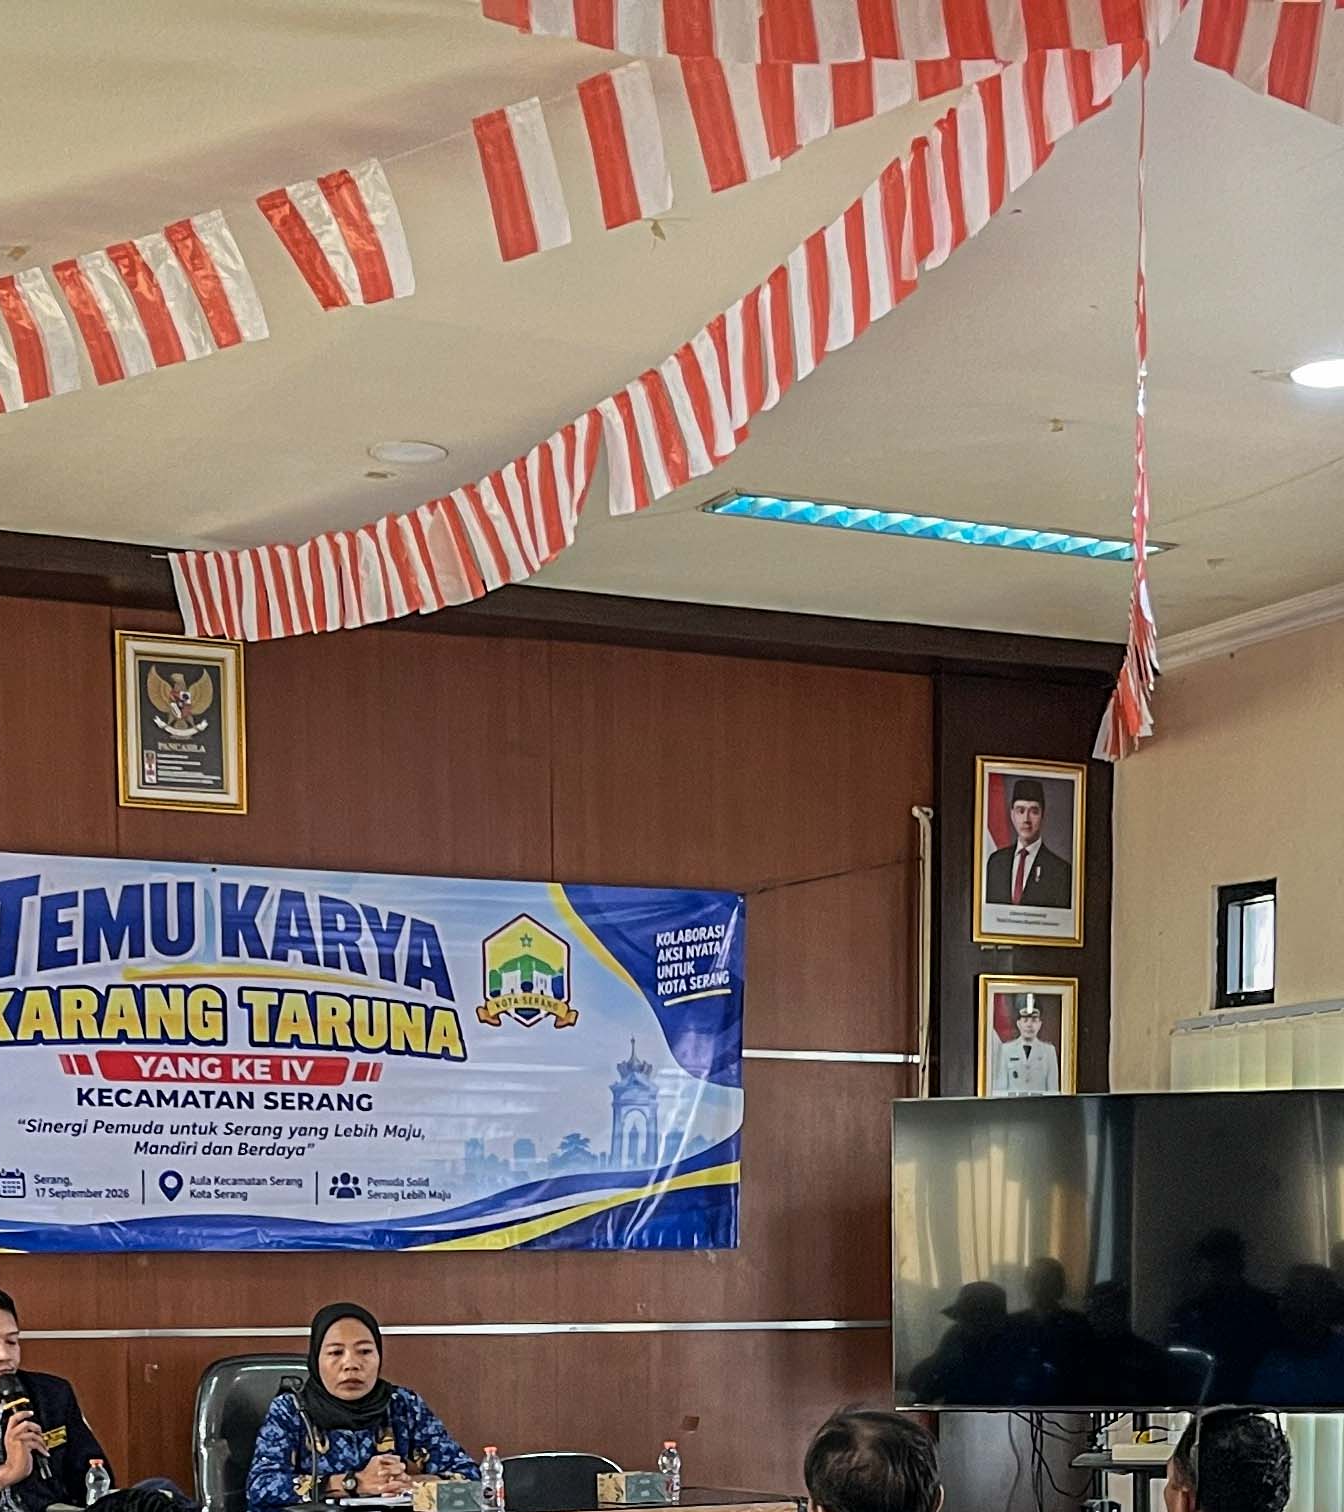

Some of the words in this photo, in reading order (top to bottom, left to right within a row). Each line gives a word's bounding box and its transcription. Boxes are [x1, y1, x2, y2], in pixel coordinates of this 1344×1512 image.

[220, 882, 456, 1002] KARYA
[656, 924, 725, 947] KOLABORASI
[657, 947, 683, 963] AKSI
[686, 941, 721, 958] NYATA
[657, 961, 695, 979] UNTUK
[658, 979, 687, 996] KOTA
[690, 970, 730, 990] SERANG
[239, 986, 467, 1061] TARUNA
[134, 1055, 222, 1080] YANG
[232, 1057, 272, 1080] KE
[282, 1059, 314, 1081] IV
[77, 1087, 254, 1110] KECAMATAN
[264, 1091, 373, 1111] SERANG
[93, 1120, 164, 1136] Pemuda
[170, 1121, 218, 1136] untuk
[223, 1122, 283, 1139] Serang
[288, 1126, 329, 1140] yang
[334, 1124, 378, 1138] Lebih
[383, 1125, 426, 1141] Maju,
[134, 1141, 197, 1156] Mandiri
[201, 1142, 233, 1156] dan
[34, 1174, 72, 1187] Serang,
[190, 1176, 212, 1187] Aula
[214, 1176, 268, 1187] Kecamatan
[269, 1177, 303, 1189] Serang
[367, 1177, 405, 1188] Pemuda
[406, 1177, 430, 1188] Solid
[35, 1188, 46, 1199] 17
[48, 1188, 103, 1201] September
[105, 1189, 130, 1199] 2026
[190, 1189, 212, 1200] Kota
[214, 1190, 248, 1202] Serang
[367, 1190, 400, 1201] Serang
[401, 1190, 426, 1201] Lebih
[428, 1191, 452, 1202] Maju
